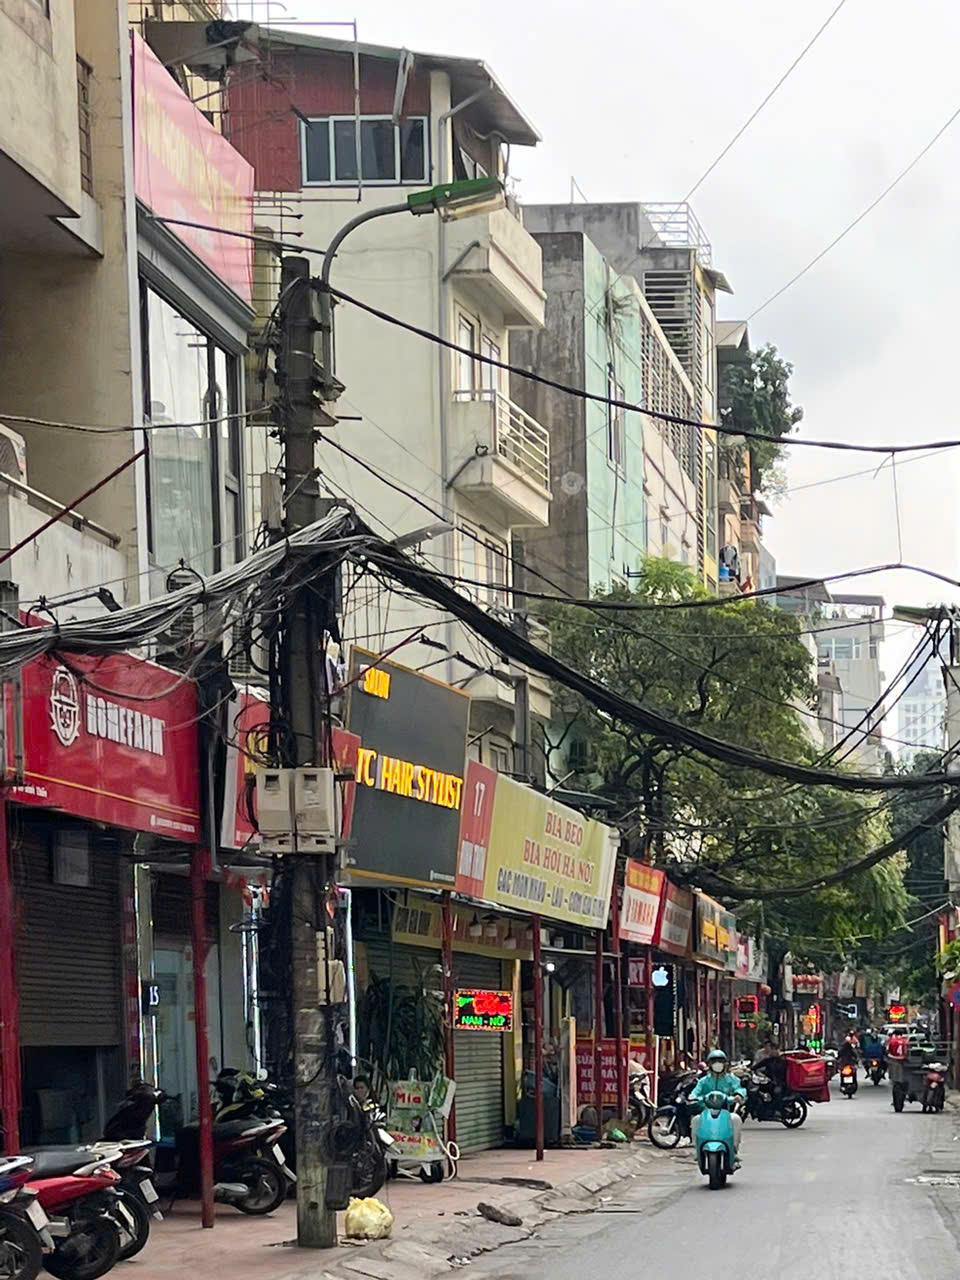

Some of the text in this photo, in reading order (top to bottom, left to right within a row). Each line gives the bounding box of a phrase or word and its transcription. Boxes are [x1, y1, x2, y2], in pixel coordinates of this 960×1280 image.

[356, 747, 464, 810] TC HAIR STYLIST
